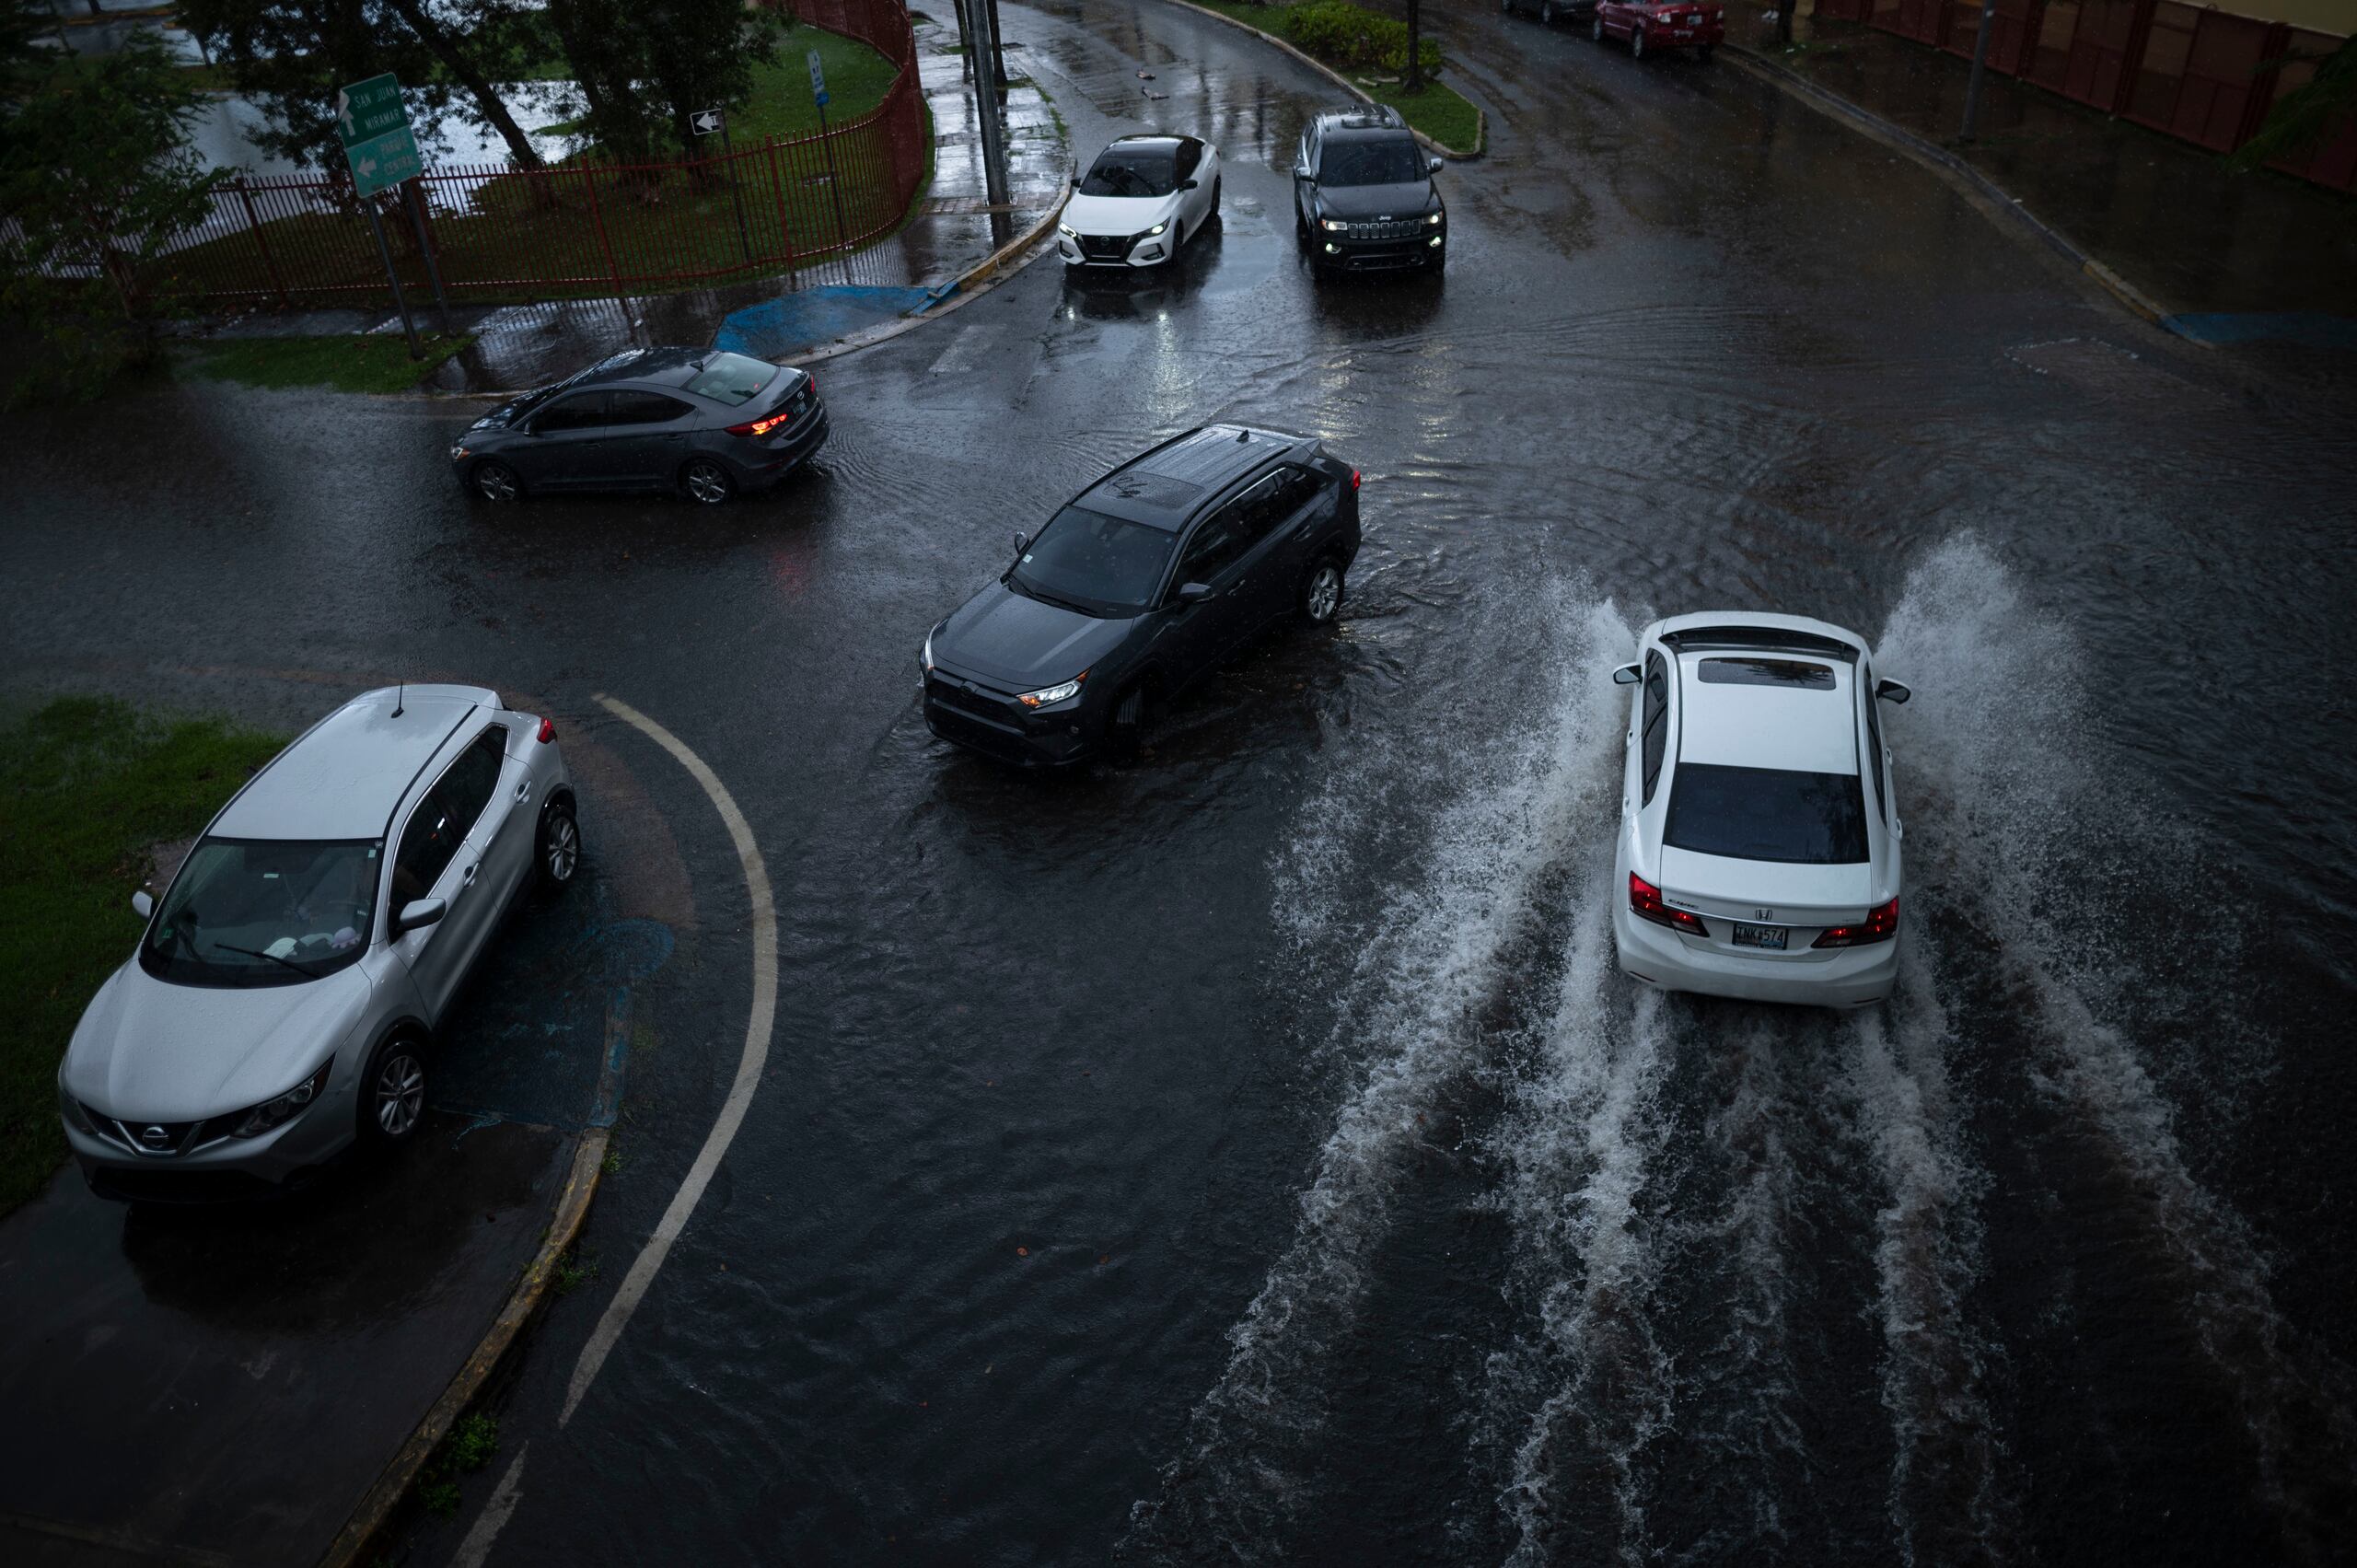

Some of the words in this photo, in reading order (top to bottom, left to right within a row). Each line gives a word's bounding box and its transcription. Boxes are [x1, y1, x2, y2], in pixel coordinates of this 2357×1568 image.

[354, 94, 372, 110] SAN
[377, 87, 397, 103] JUAN
[365, 110, 401, 132] MIRAMAR
